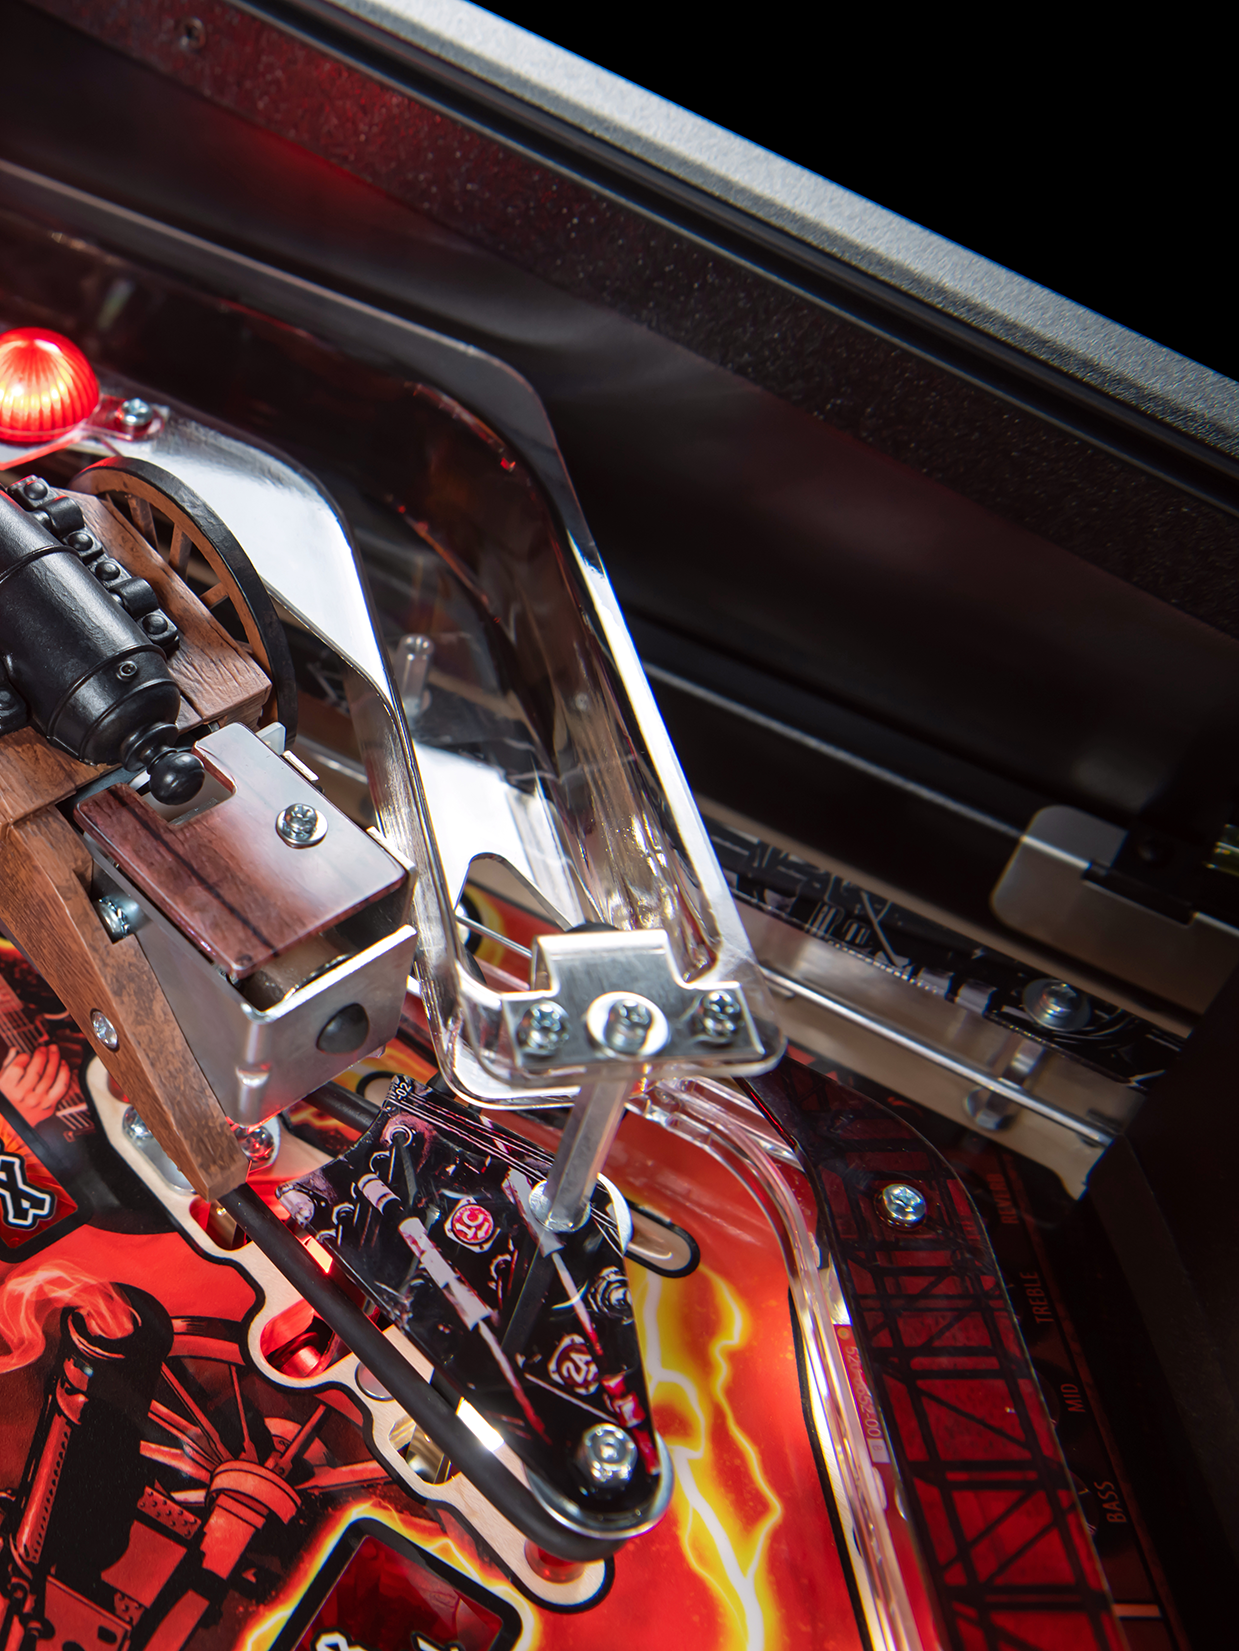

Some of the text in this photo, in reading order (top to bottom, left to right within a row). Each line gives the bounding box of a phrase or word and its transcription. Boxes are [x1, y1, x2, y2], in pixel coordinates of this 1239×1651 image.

[988, 1173, 1020, 1226] REVERB
[1019, 1270, 1054, 1325] TREBLE
[1060, 1381, 1086, 1414] MID
[1093, 1480, 1128, 1524] BASS
